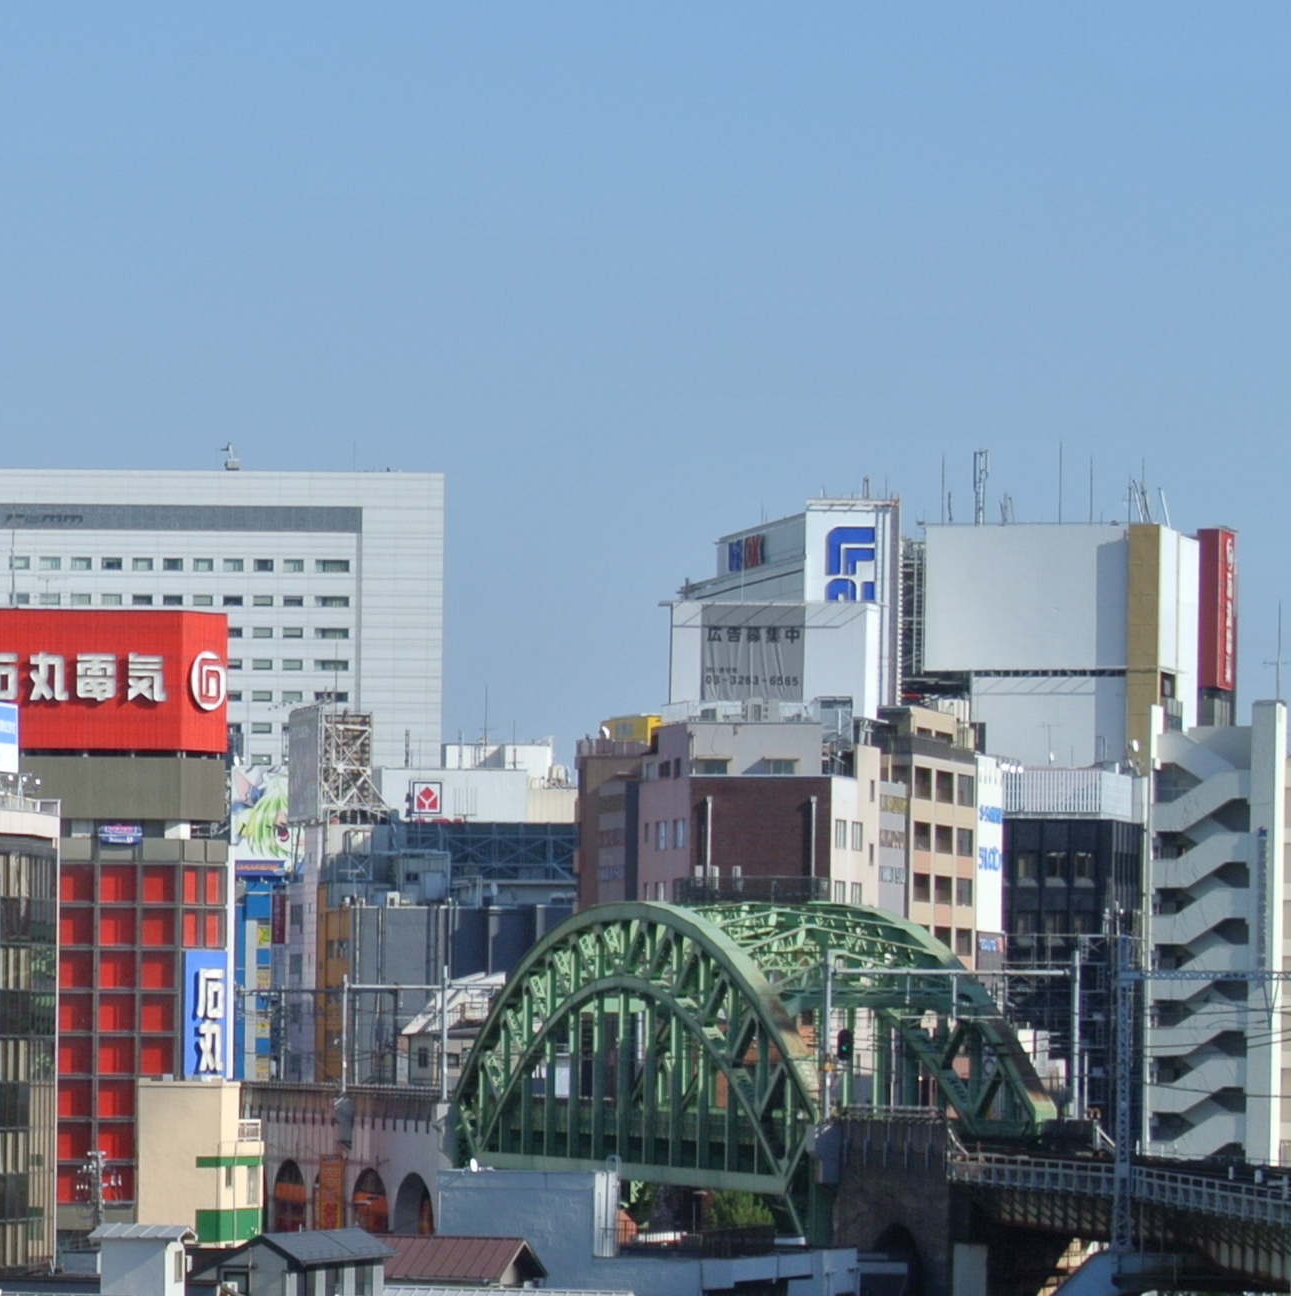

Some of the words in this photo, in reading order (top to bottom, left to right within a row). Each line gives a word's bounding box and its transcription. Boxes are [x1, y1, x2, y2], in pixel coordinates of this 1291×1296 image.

[707, 626, 800, 644] 広告募集中
[196, 967, 225, 1072] 石丸
